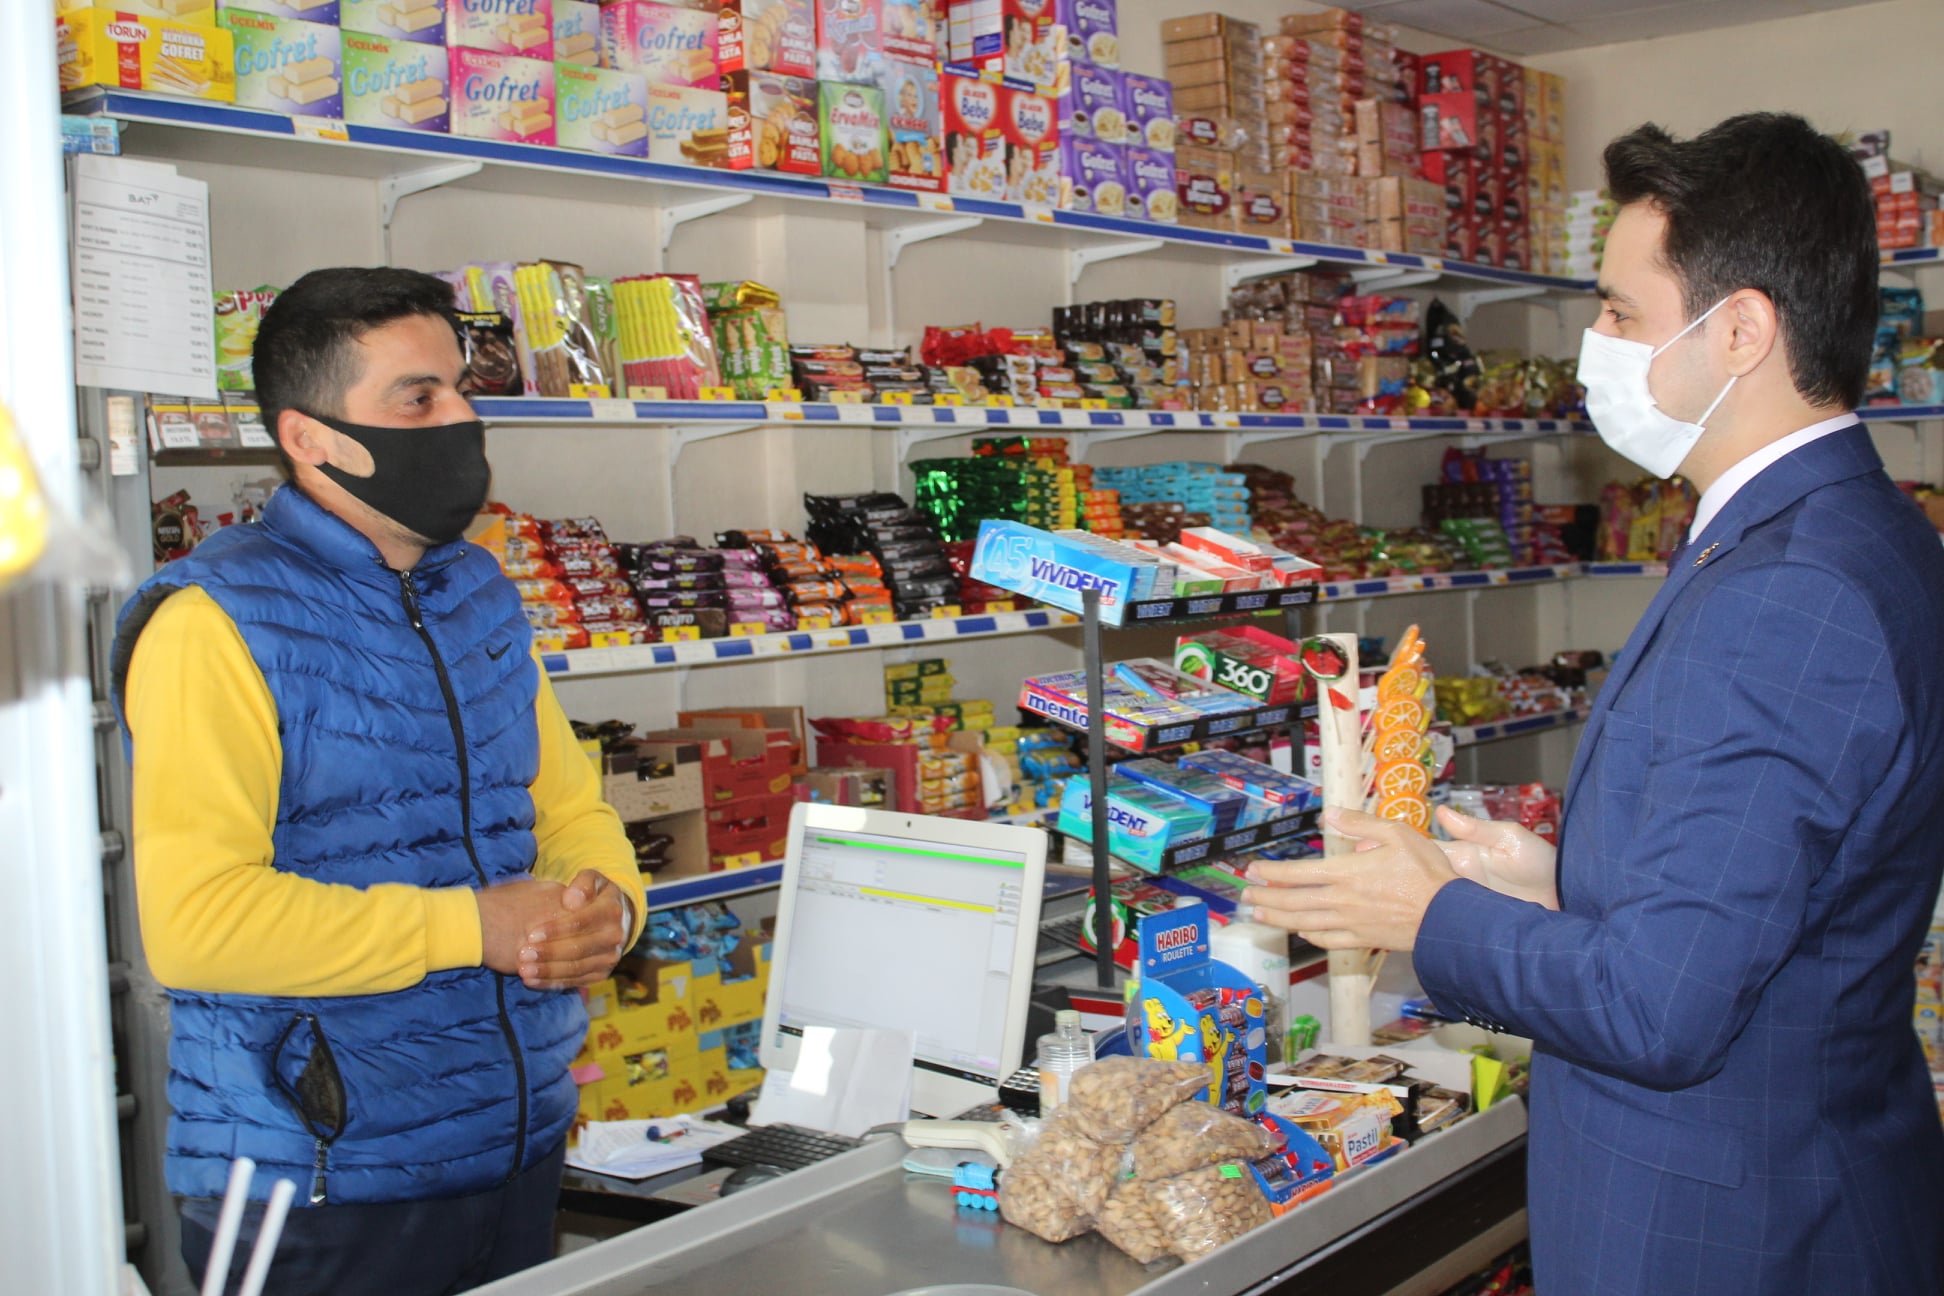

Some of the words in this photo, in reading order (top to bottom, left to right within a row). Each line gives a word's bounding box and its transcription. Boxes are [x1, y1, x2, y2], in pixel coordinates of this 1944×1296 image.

[107, 24, 147, 39] TORUN
[638, 25, 705, 50] Gofret
[235, 33, 317, 76] Gofret
[350, 55, 428, 97] Gofret
[465, 75, 541, 101] Gofret
[564, 83, 631, 122] Gofret
[961, 97, 989, 119] Bebe
[650, 105, 717, 130] Gofret
[1018, 110, 1045, 133] Bebe
[657, 613, 695, 627] negro
[1028, 693, 1089, 728] mento
[1156, 924, 1198, 952] HARIBO
[1162, 946, 1194, 962] ROULETTE
[1348, 1128, 1378, 1156] Pastil
